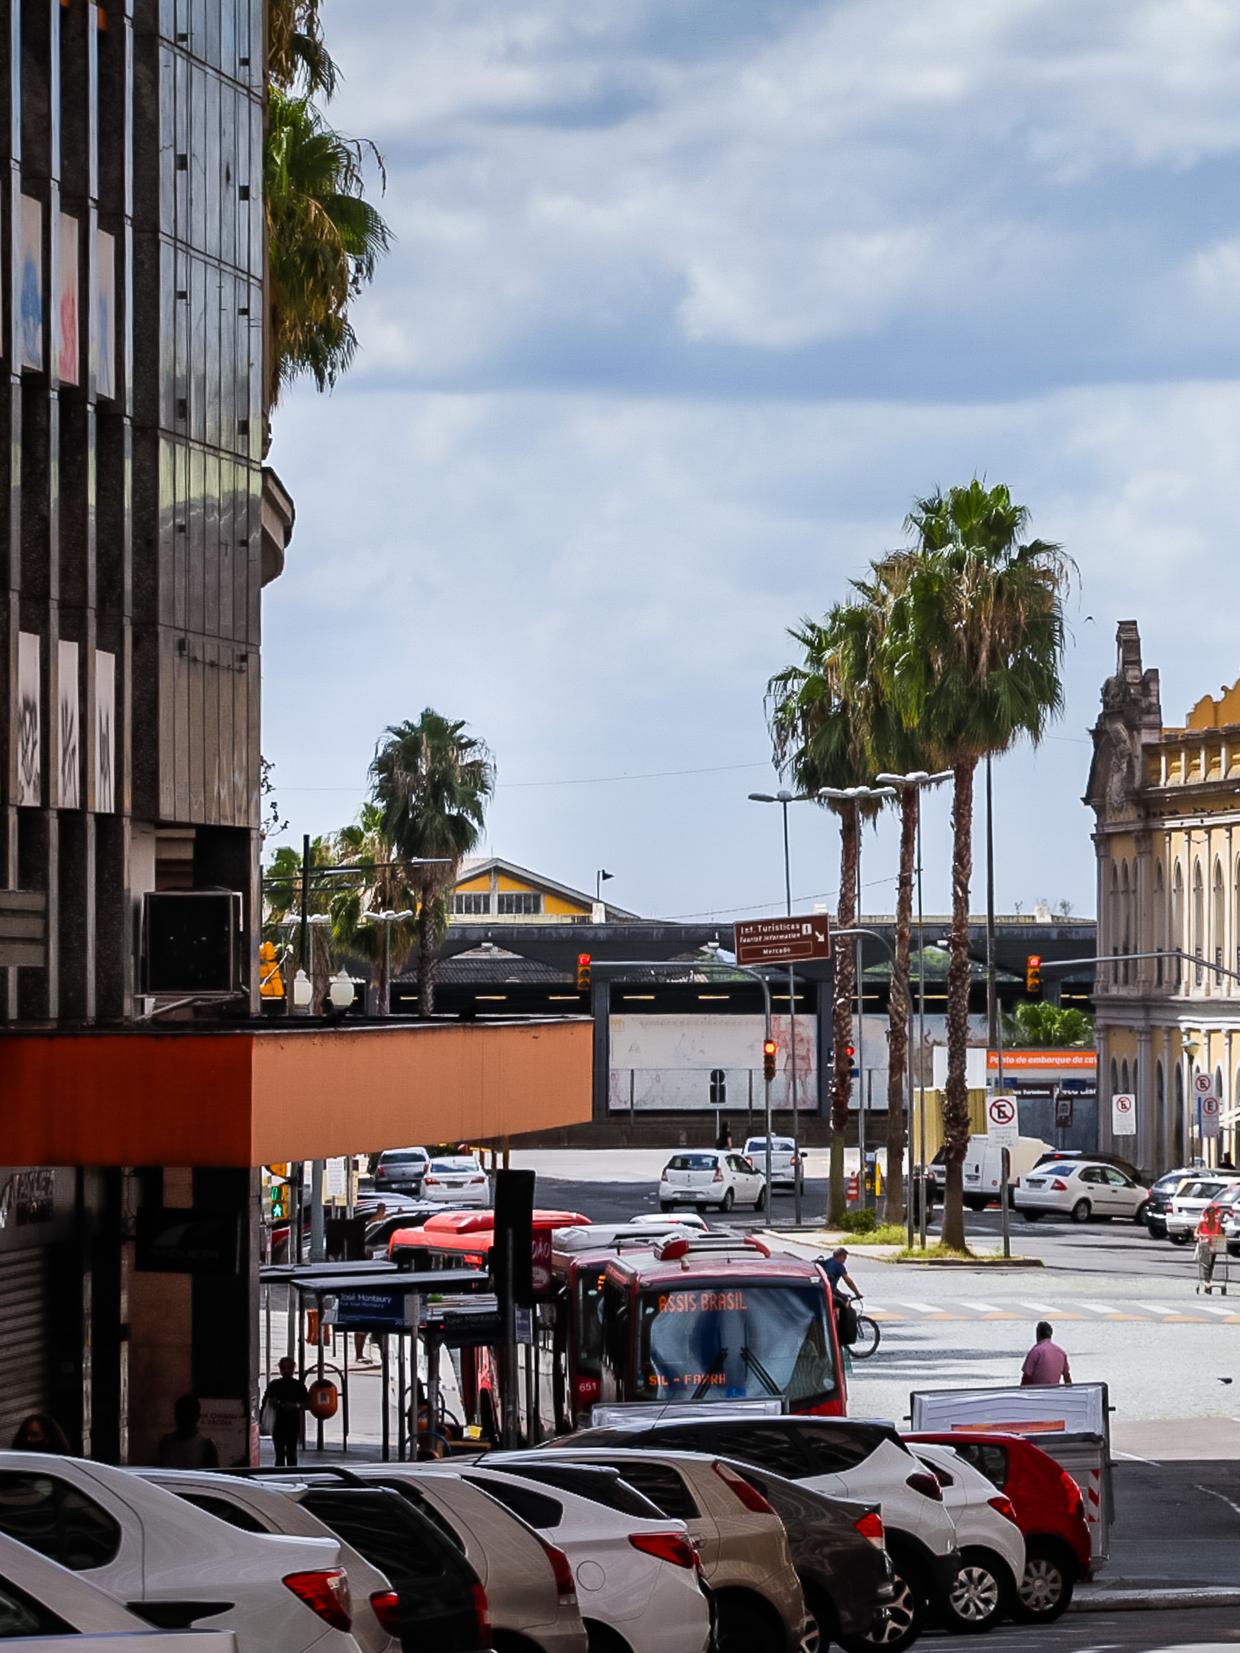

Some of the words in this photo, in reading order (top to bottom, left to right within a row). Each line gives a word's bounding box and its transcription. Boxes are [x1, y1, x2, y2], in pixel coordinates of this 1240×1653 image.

[658, 1295, 697, 1313] ASSIS
[700, 1292, 748, 1312] BRASIL
[579, 1381, 598, 1392] 651
